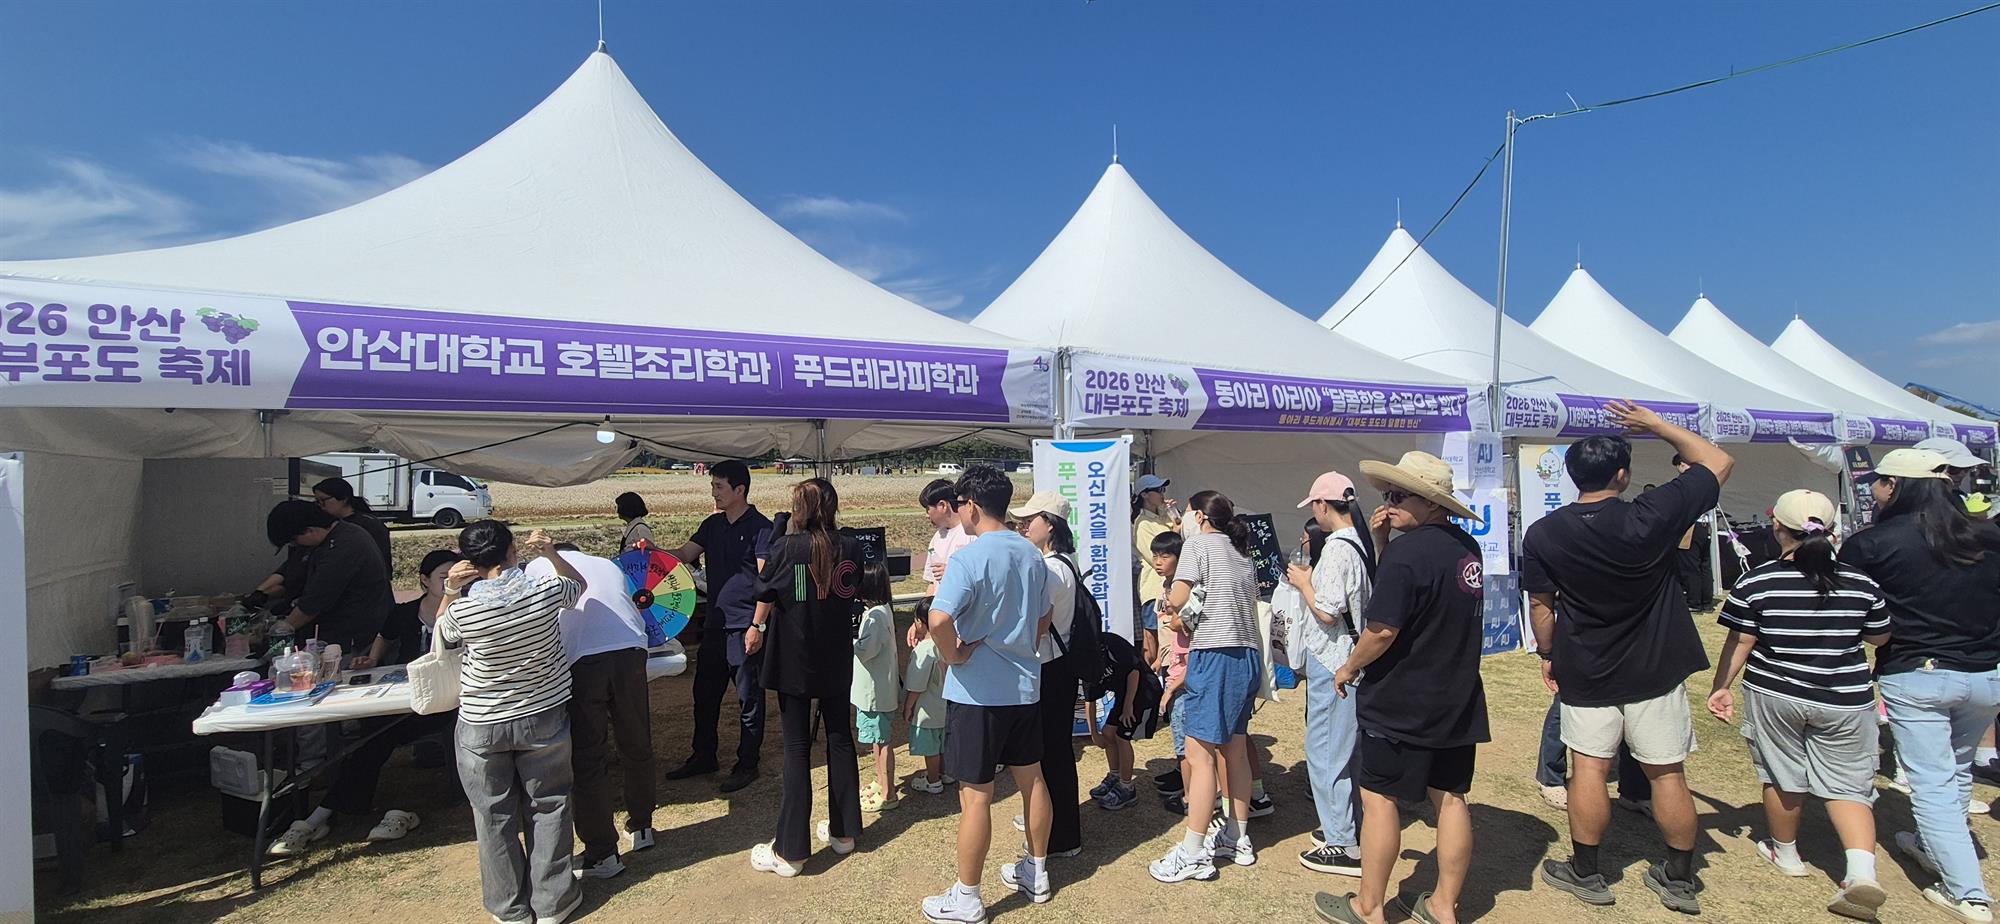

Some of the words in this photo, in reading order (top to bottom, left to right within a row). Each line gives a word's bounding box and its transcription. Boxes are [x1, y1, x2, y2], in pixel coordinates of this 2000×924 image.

[0, 302, 68, 337] 26
[88, 304, 185, 343] 안산
[159, 346, 252, 387] 축제
[316, 326, 543, 377] 안산대학교
[557, 341, 771, 386] 호텔조리학과
[794, 353, 979, 396] 푸드테라피학과
[1086, 370, 1130, 391] 2026
[1135, 373, 1166, 395] 안산
[1085, 393, 1153, 417] 대부포도
[1159, 397, 1189, 417] 축제
[1214, 380, 1269, 409] 동아리
[1272, 384, 1321, 412] 아리아
[1389, 392, 1439, 416] 손끝으로
[1506, 396, 1530, 411] 2026
[1531, 398, 1548, 413] 안산
[1279, 414, 1301, 424] 동아리
[1505, 412, 1541, 429] 대부포도
[1542, 414, 1559, 429] 축제
[1088, 461, 1106, 497] 오신
[1544, 492, 1562, 516] 푸
[1089, 502, 1108, 539] 것을
